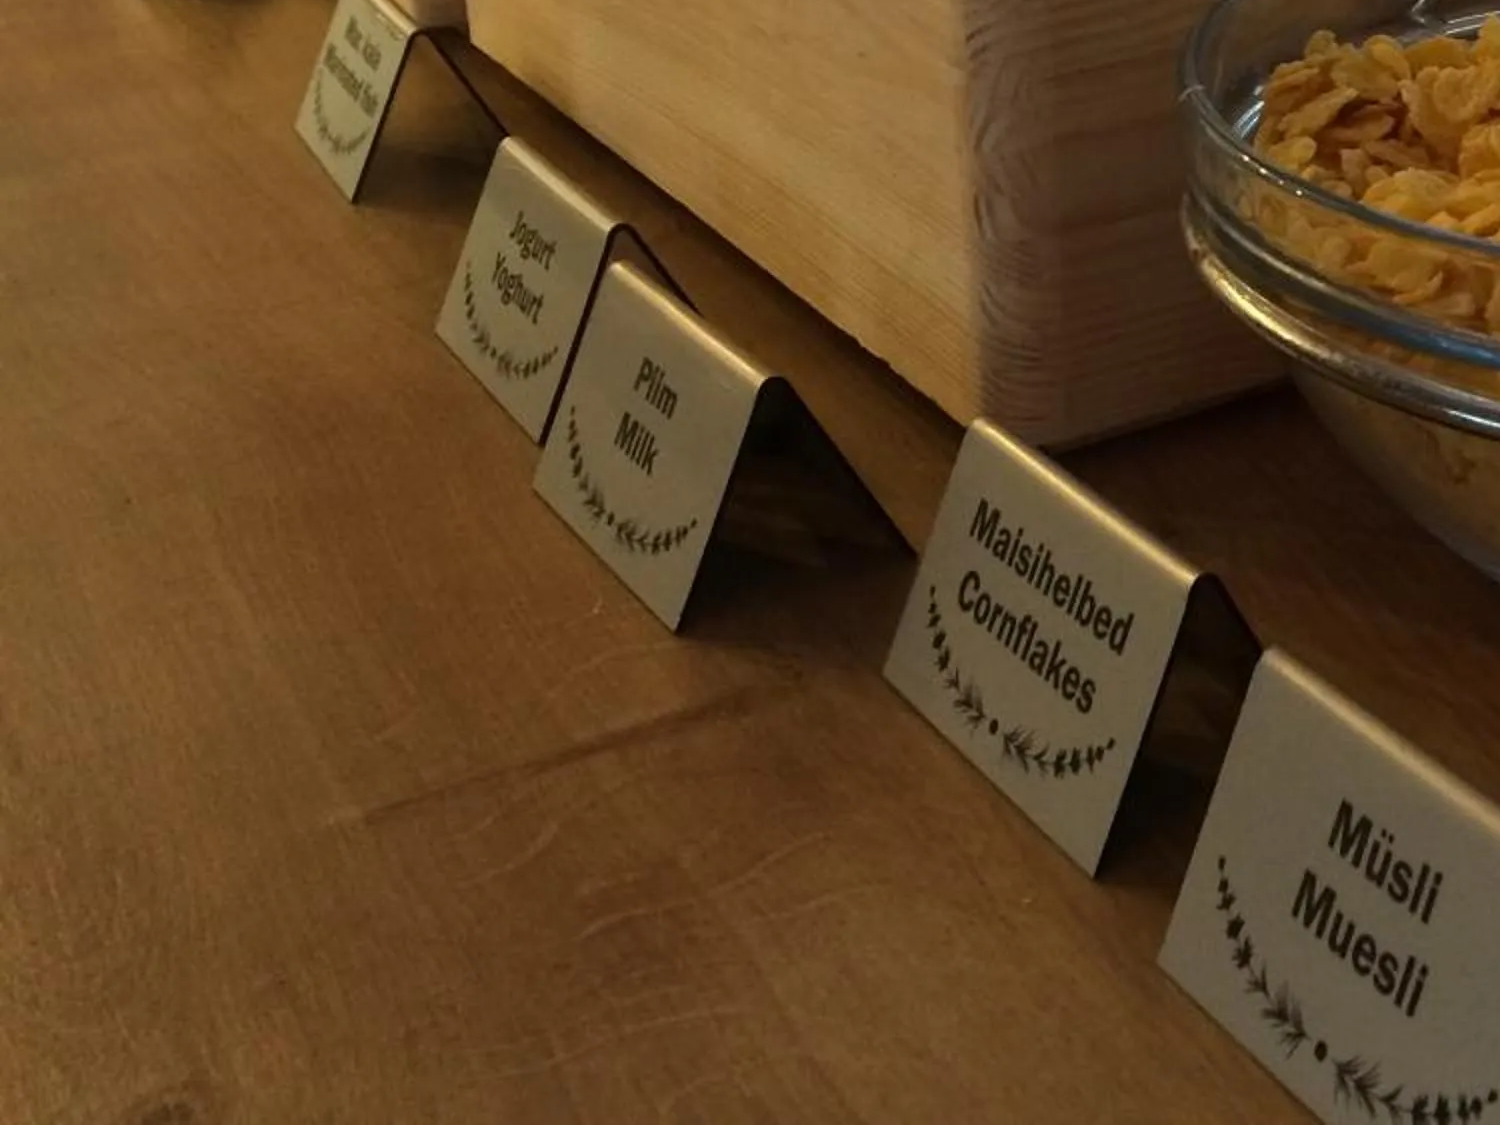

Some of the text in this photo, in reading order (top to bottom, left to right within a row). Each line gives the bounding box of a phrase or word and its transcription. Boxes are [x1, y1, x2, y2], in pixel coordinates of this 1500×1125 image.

[508, 210, 557, 272] Jogurt
[613, 412, 659, 476] Milk
[957, 570, 1097, 715] Cornflakes
[968, 497, 1135, 656] Maisihelbed
[1327, 799, 1444, 925] Müsli
[1290, 869, 1430, 1018] Muesli
